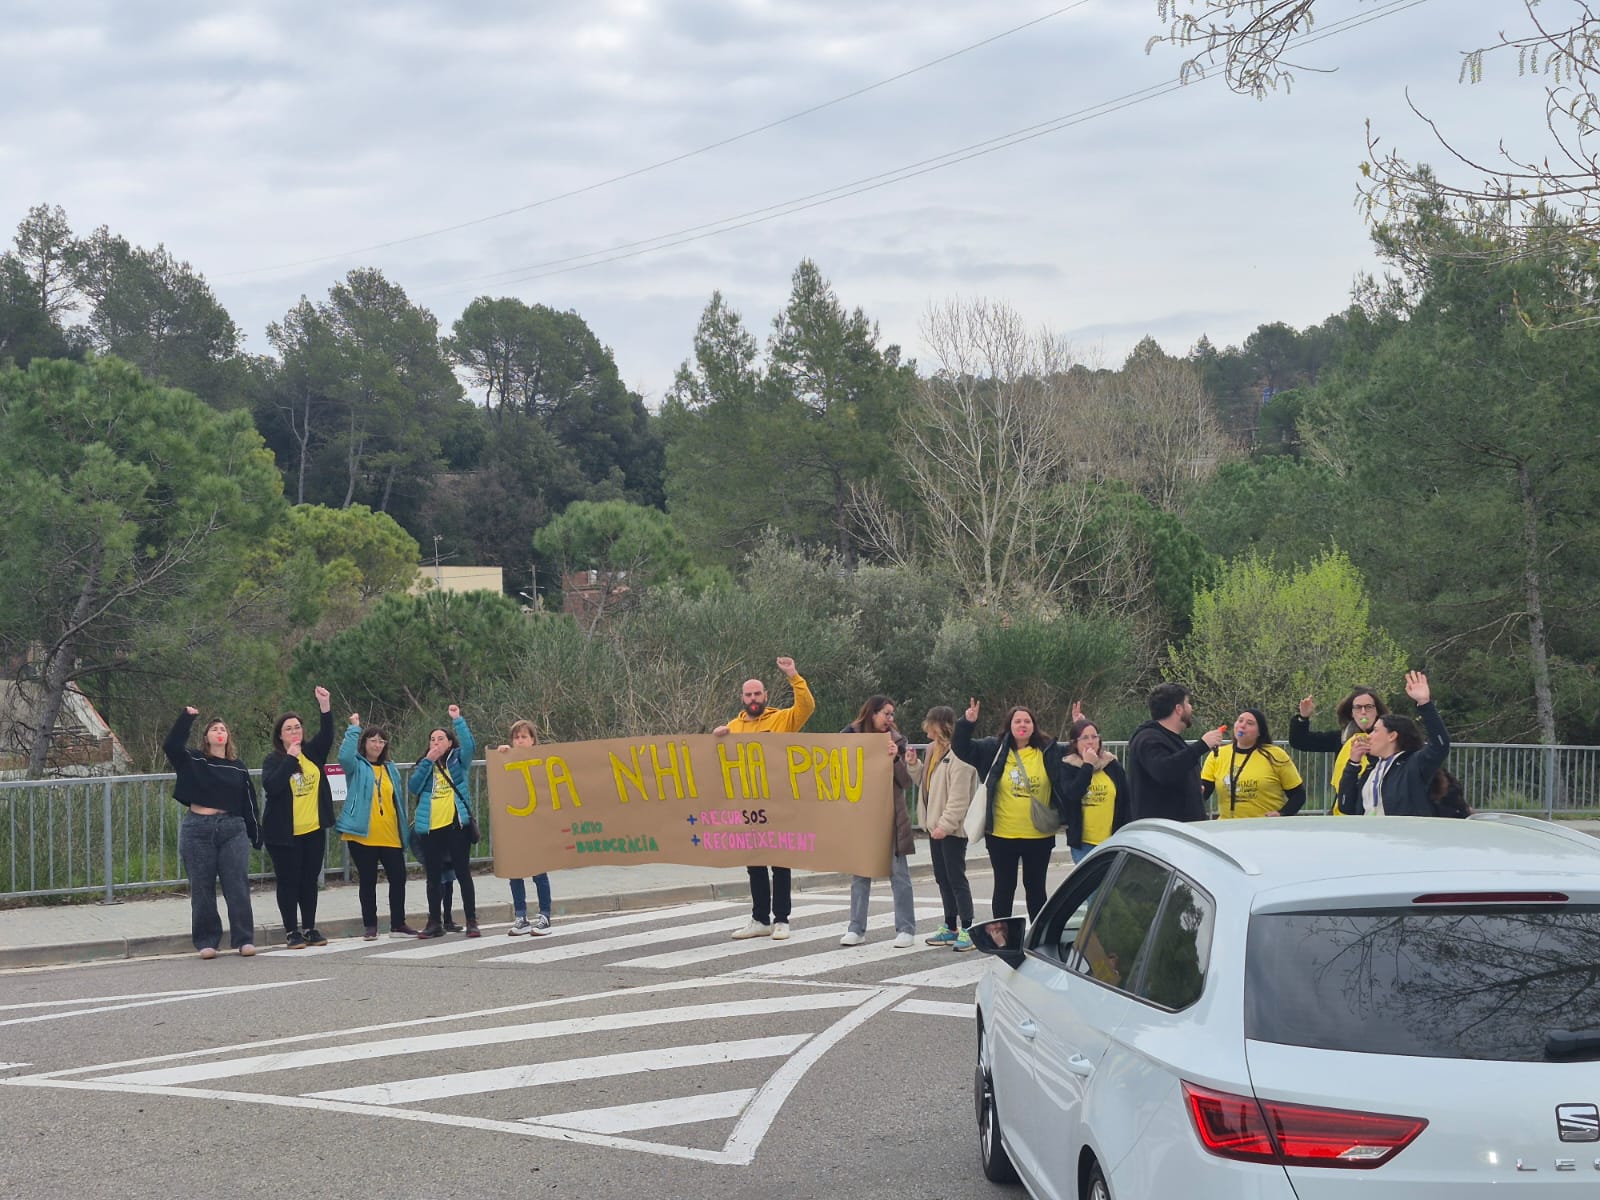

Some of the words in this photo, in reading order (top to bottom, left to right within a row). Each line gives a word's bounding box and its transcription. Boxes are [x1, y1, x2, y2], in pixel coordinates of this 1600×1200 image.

[504, 756, 583, 817] JA
[717, 741, 771, 800] HA
[786, 745, 864, 803] PROU
